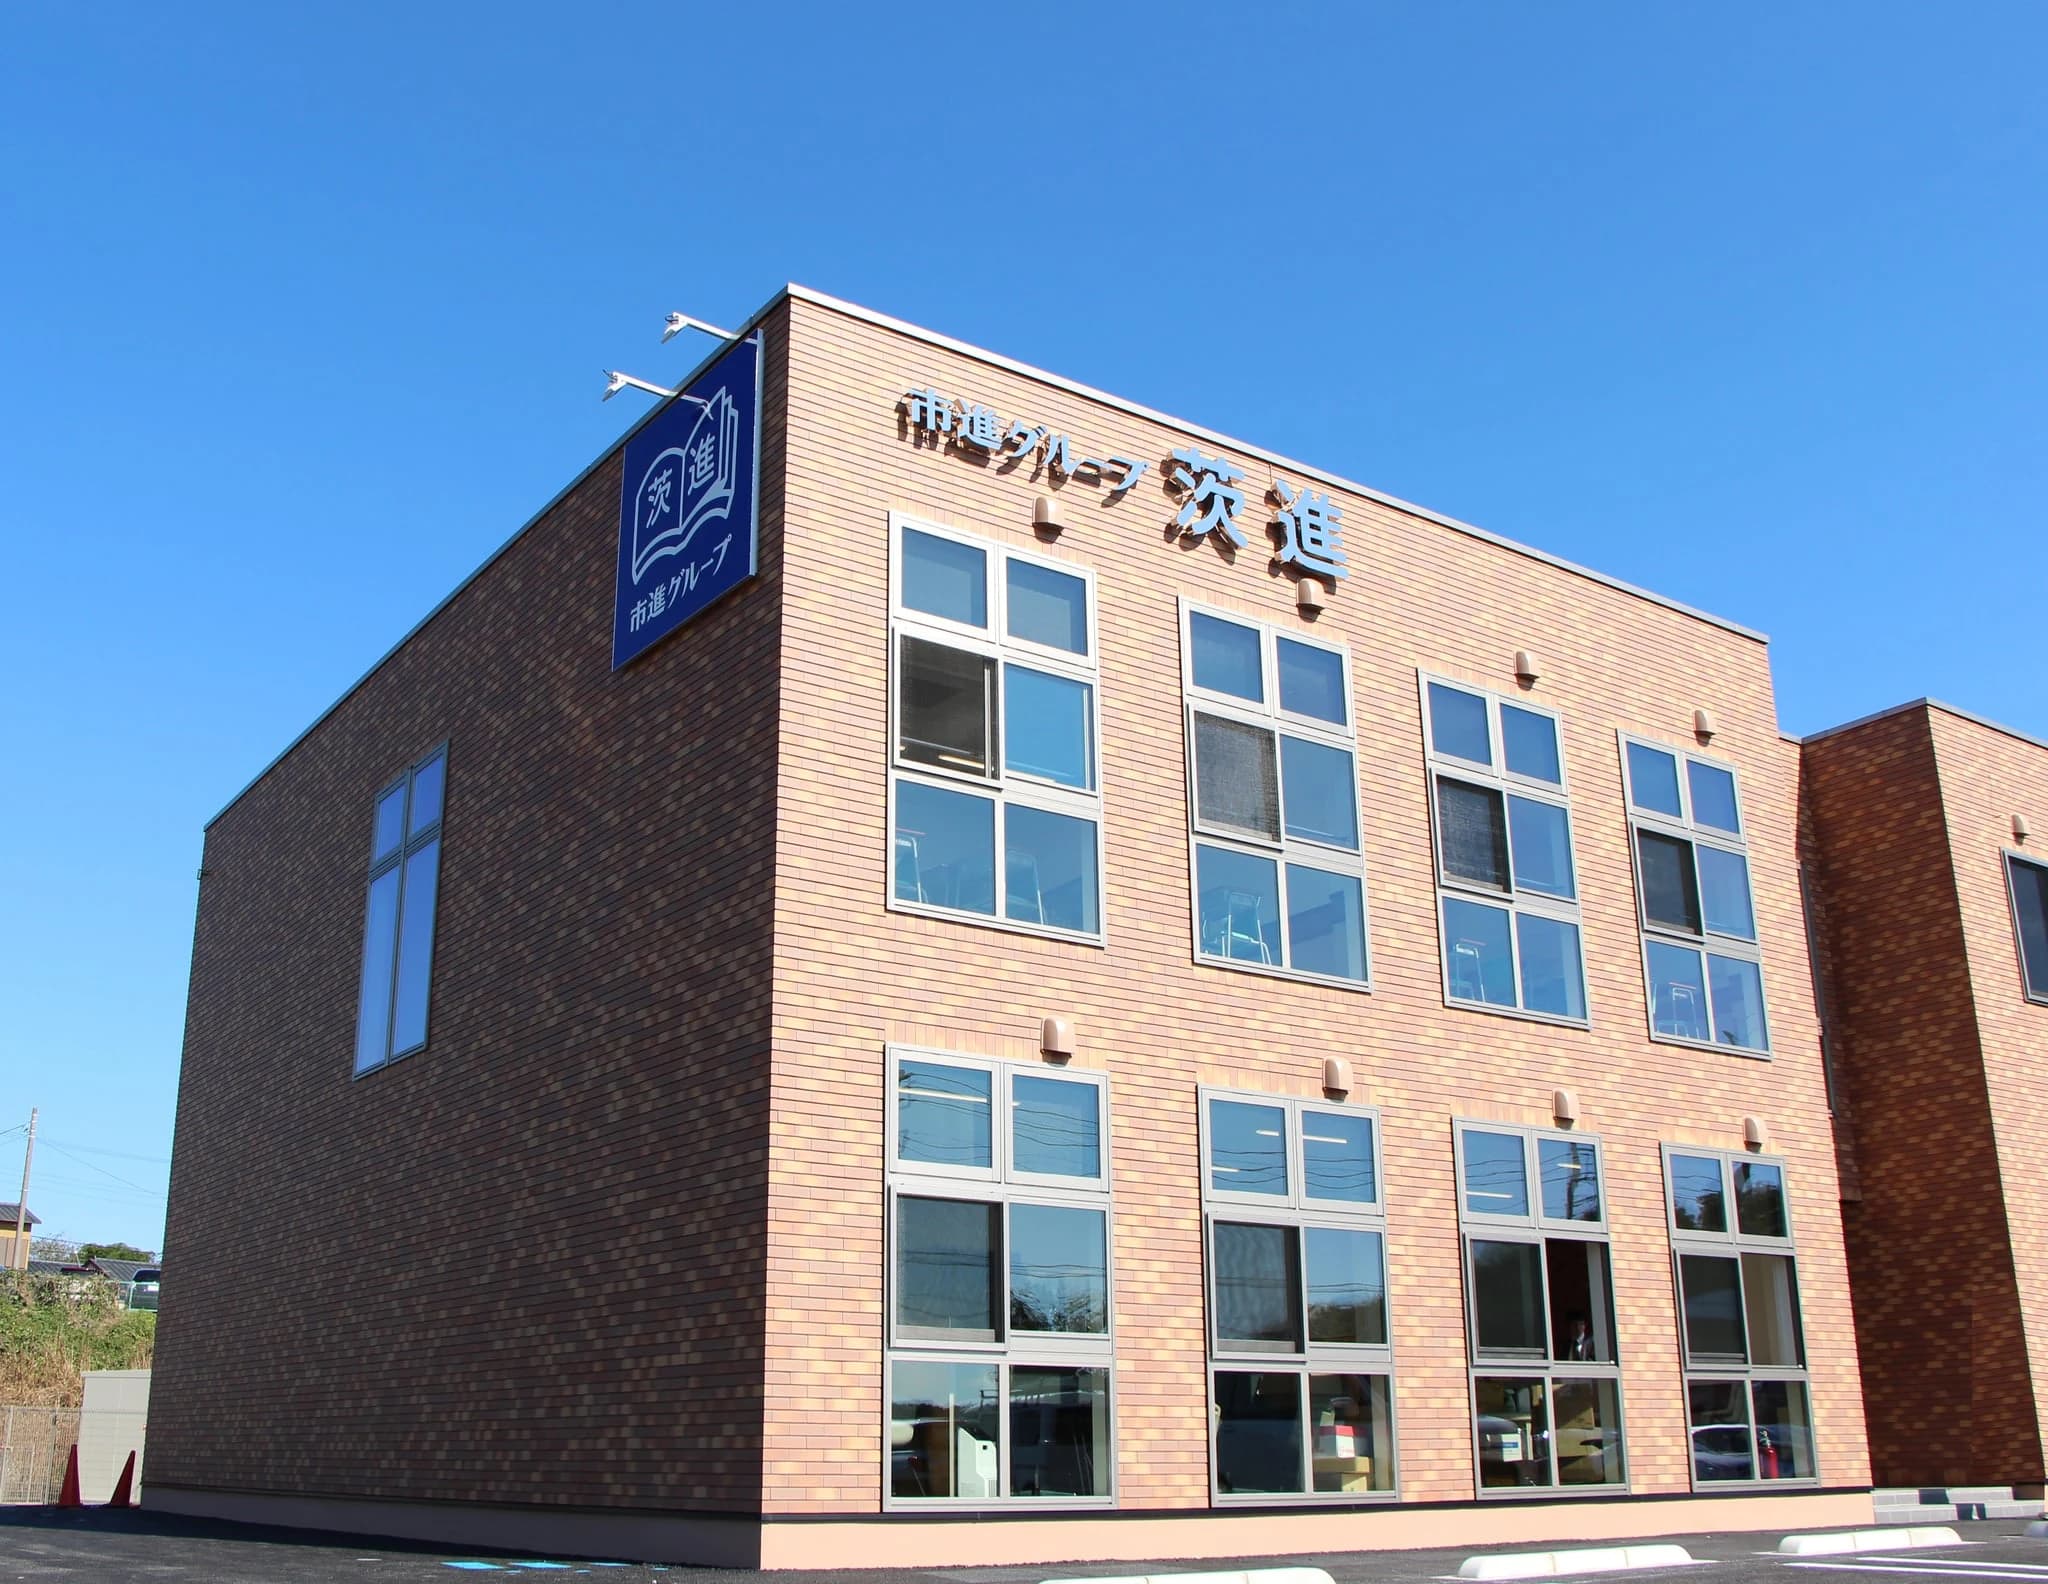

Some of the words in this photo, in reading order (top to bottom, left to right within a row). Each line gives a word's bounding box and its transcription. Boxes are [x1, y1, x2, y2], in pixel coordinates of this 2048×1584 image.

[646, 433, 716, 528] 茨進
[905, 388, 1150, 492] 市進グループ
[1168, 446, 1350, 581] 茨進
[629, 533, 732, 633] 市進グループ
